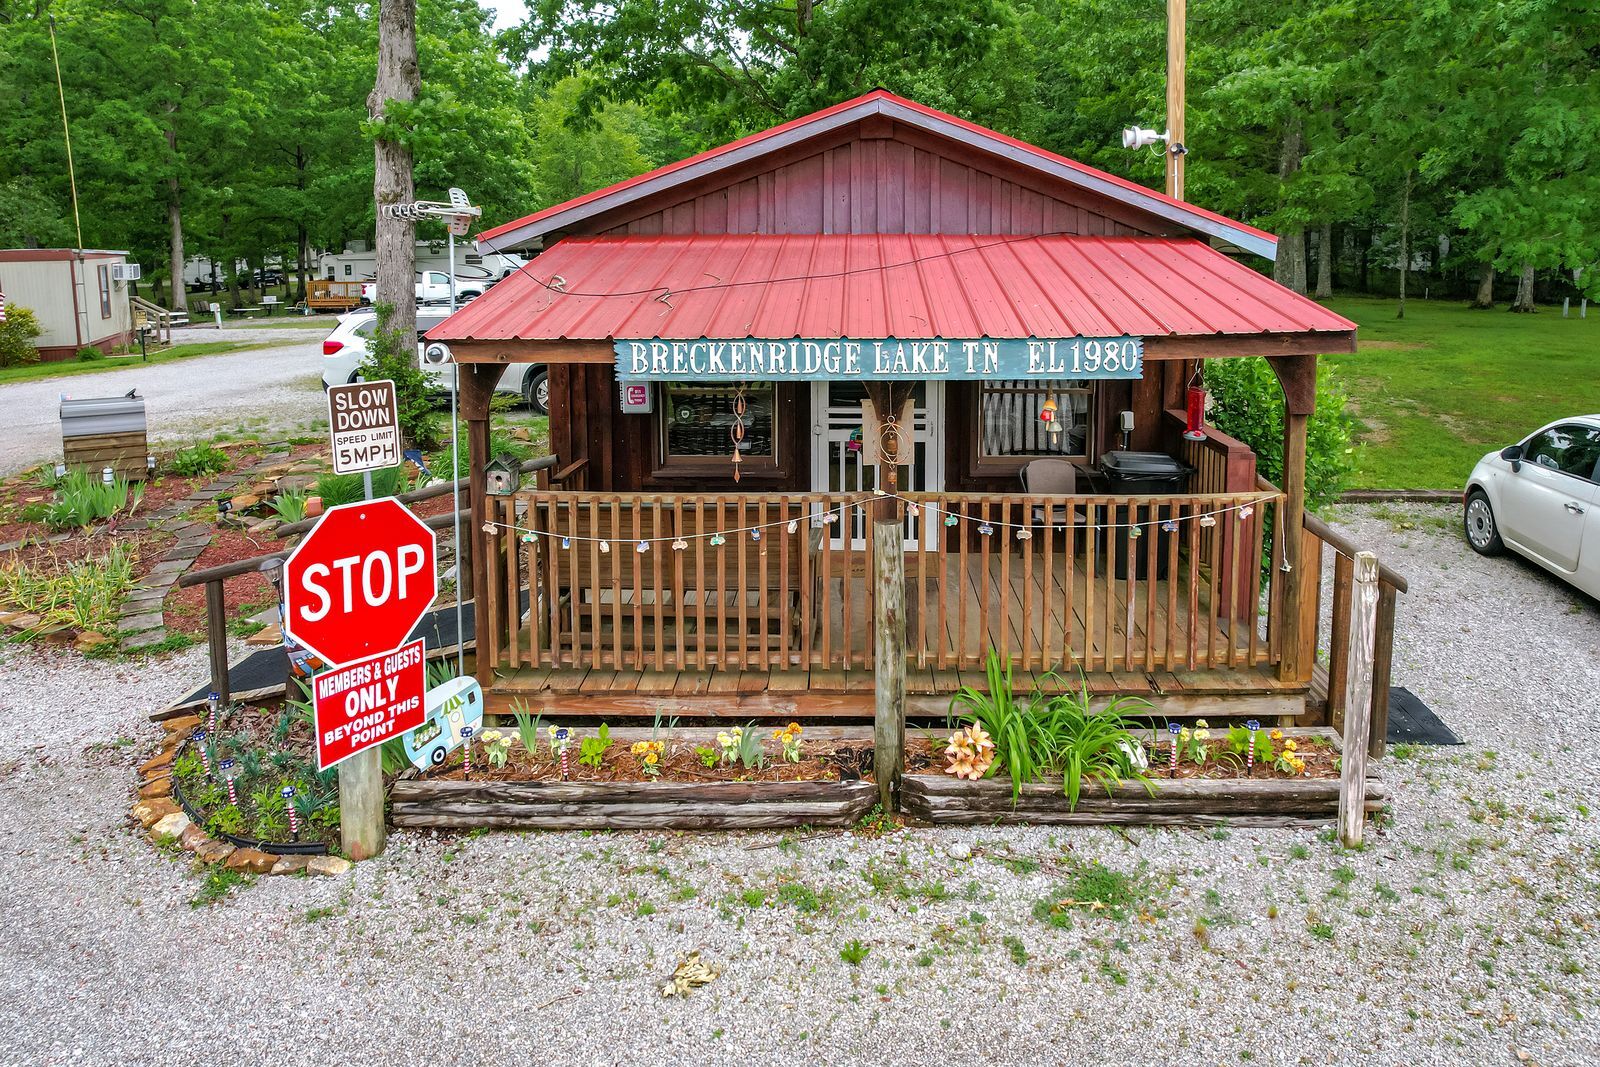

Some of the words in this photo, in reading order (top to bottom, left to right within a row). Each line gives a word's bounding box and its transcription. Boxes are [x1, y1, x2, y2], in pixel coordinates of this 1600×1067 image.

[629, 341, 861, 374] BRECKENRIDGE
[872, 341, 949, 374] LAKE
[962, 341, 1000, 374] TN
[335, 388, 388, 411] SLOW
[337, 407, 390, 430] DOWN
[337, 434, 367, 446] SPEED
[371, 431, 393, 441] LIMIT
[300, 543, 425, 623] STOP
[374, 661, 382, 680] &
[384, 645, 421, 676] GUESTS
[345, 675, 399, 718] ONLY
[324, 710, 385, 746] BEYOND
[388, 696, 420, 718] THIS
[351, 719, 396, 748] POINT
